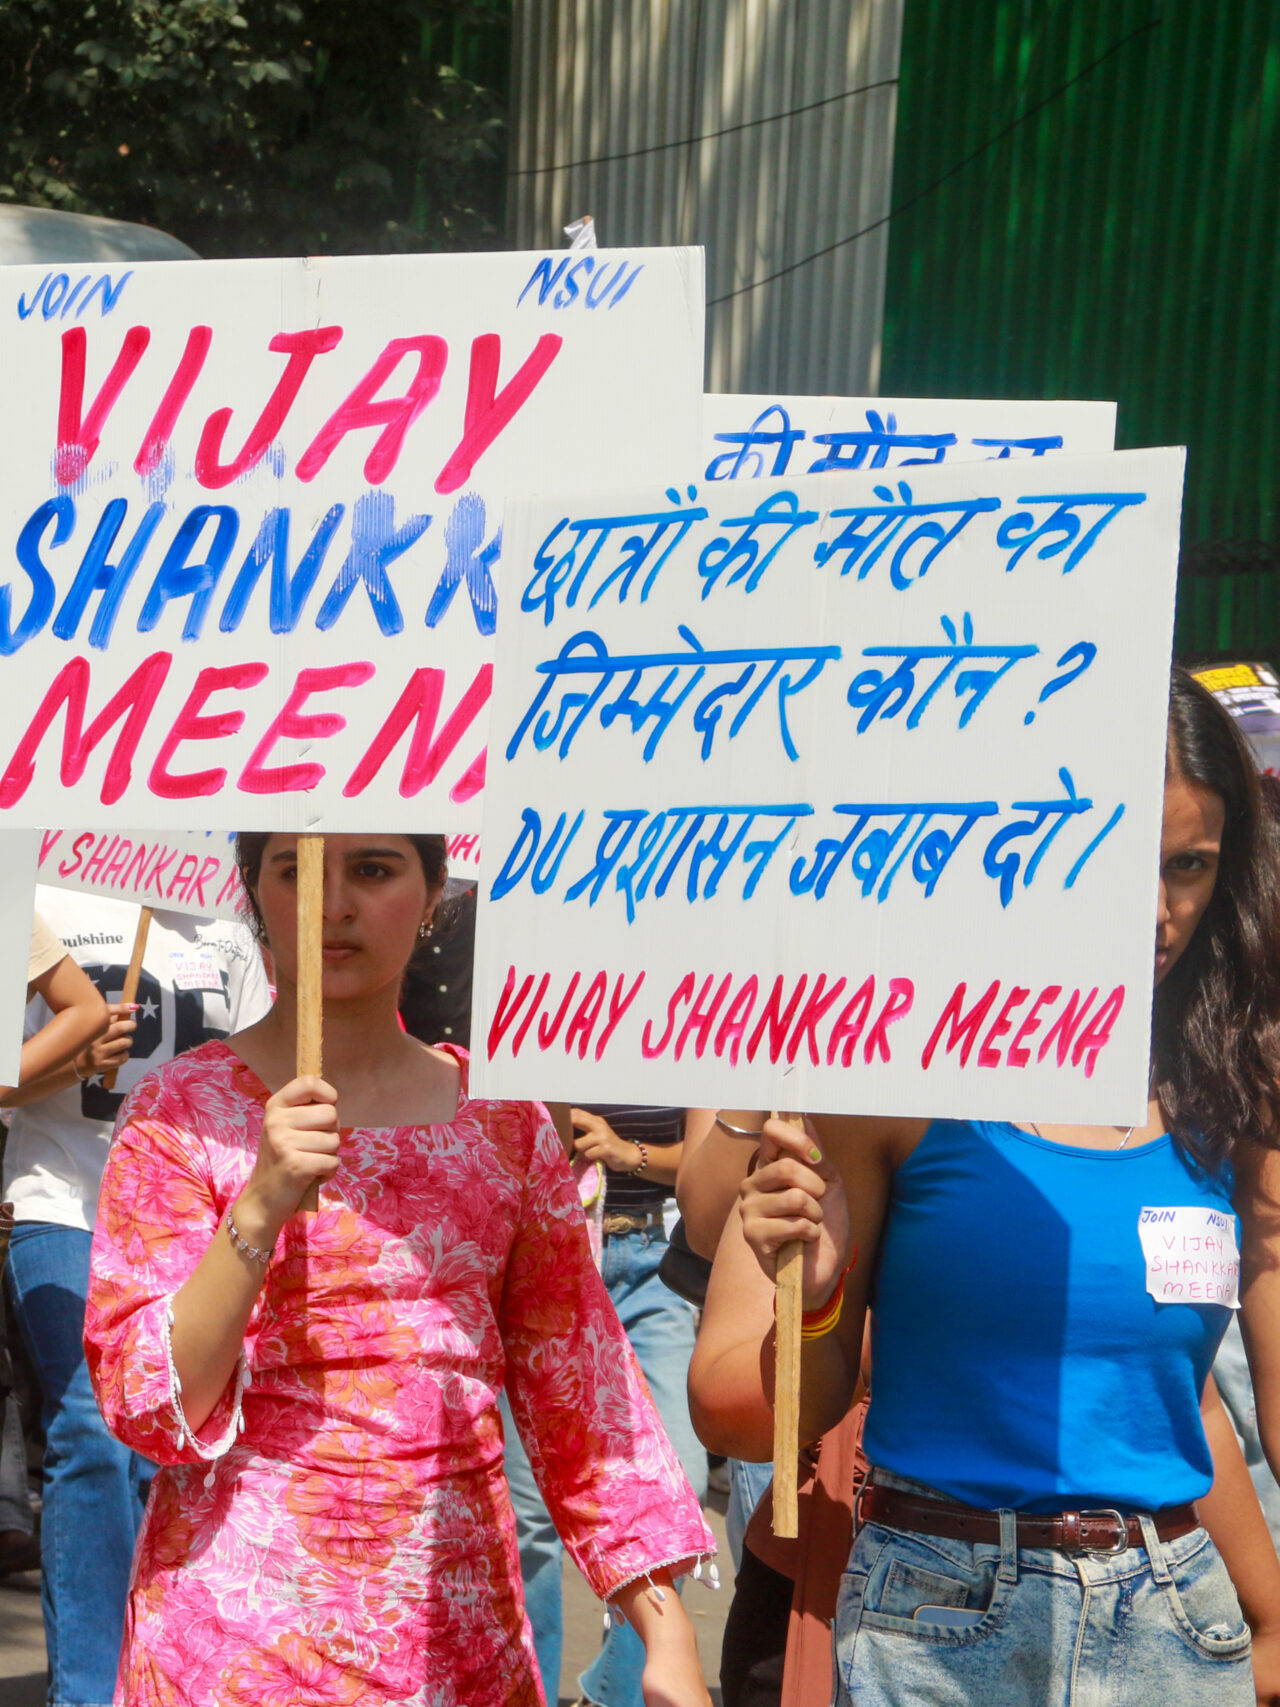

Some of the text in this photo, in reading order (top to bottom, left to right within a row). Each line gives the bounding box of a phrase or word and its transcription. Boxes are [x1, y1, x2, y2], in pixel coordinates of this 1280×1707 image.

[16, 256, 646, 321] JOIN NSUI
[56, 325, 564, 494] VIJAY
[698, 490, 819, 602] की
[813, 480, 1002, 591] मौत
[996, 492, 1147, 575] का
[506, 624, 842, 763] जिम्मेदार
[847, 612, 1039, 734] कौन
[58, 831, 220, 908] SHANKAR
[489, 807, 586, 902] DU
[563, 803, 815, 926] प्रशासन
[59, 932, 123, 948] ulshine
[487, 965, 1125, 1078] VIJAY SHANKAR MEENA
[1142, 1210, 1176, 1223] JOIN
[1163, 1236, 1223, 1256] VIJAY
[1163, 1282, 1231, 1299] MEENA
